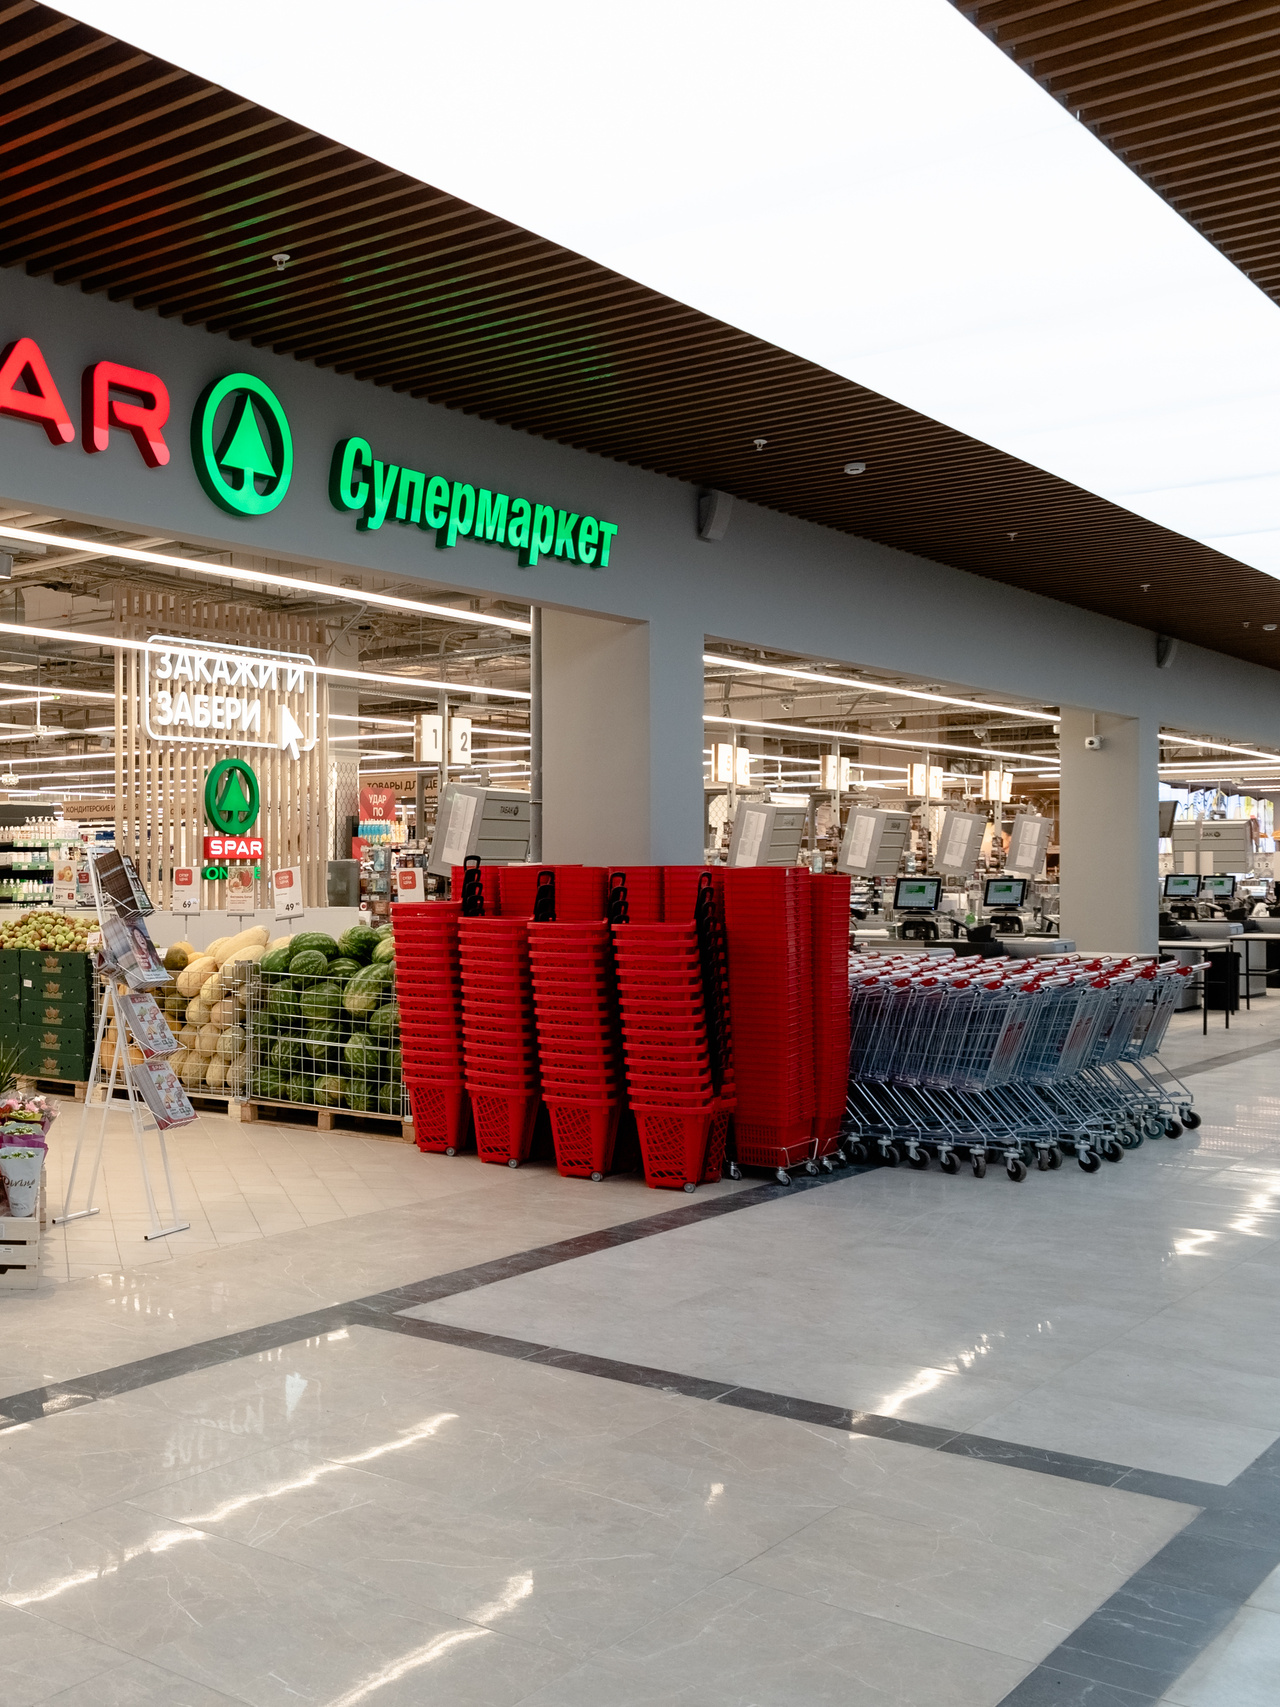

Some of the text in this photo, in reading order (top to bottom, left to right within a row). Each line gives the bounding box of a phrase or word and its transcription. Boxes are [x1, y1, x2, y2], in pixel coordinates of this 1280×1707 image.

[329, 437, 618, 568] Супермаркет
[154, 650, 305, 694] ЗАКАЖИ И
[154, 690, 261, 735] ЗАБЕРИ
[432, 729, 438, 749] 1
[460, 732, 468, 751] 2
[726, 755, 731, 771] 5
[367, 781, 403, 791] ТОВАРЫ
[404, 779, 417, 791] ДЛ
[369, 794, 387, 806] УДАР
[65, 804, 110, 813] КОНДИТЕРСКИЕ
[372, 806, 384, 816] ПО
[210, 840, 262, 855] SPAR
[204, 866, 261, 880] ONE
[285, 903, 295, 911] 49
